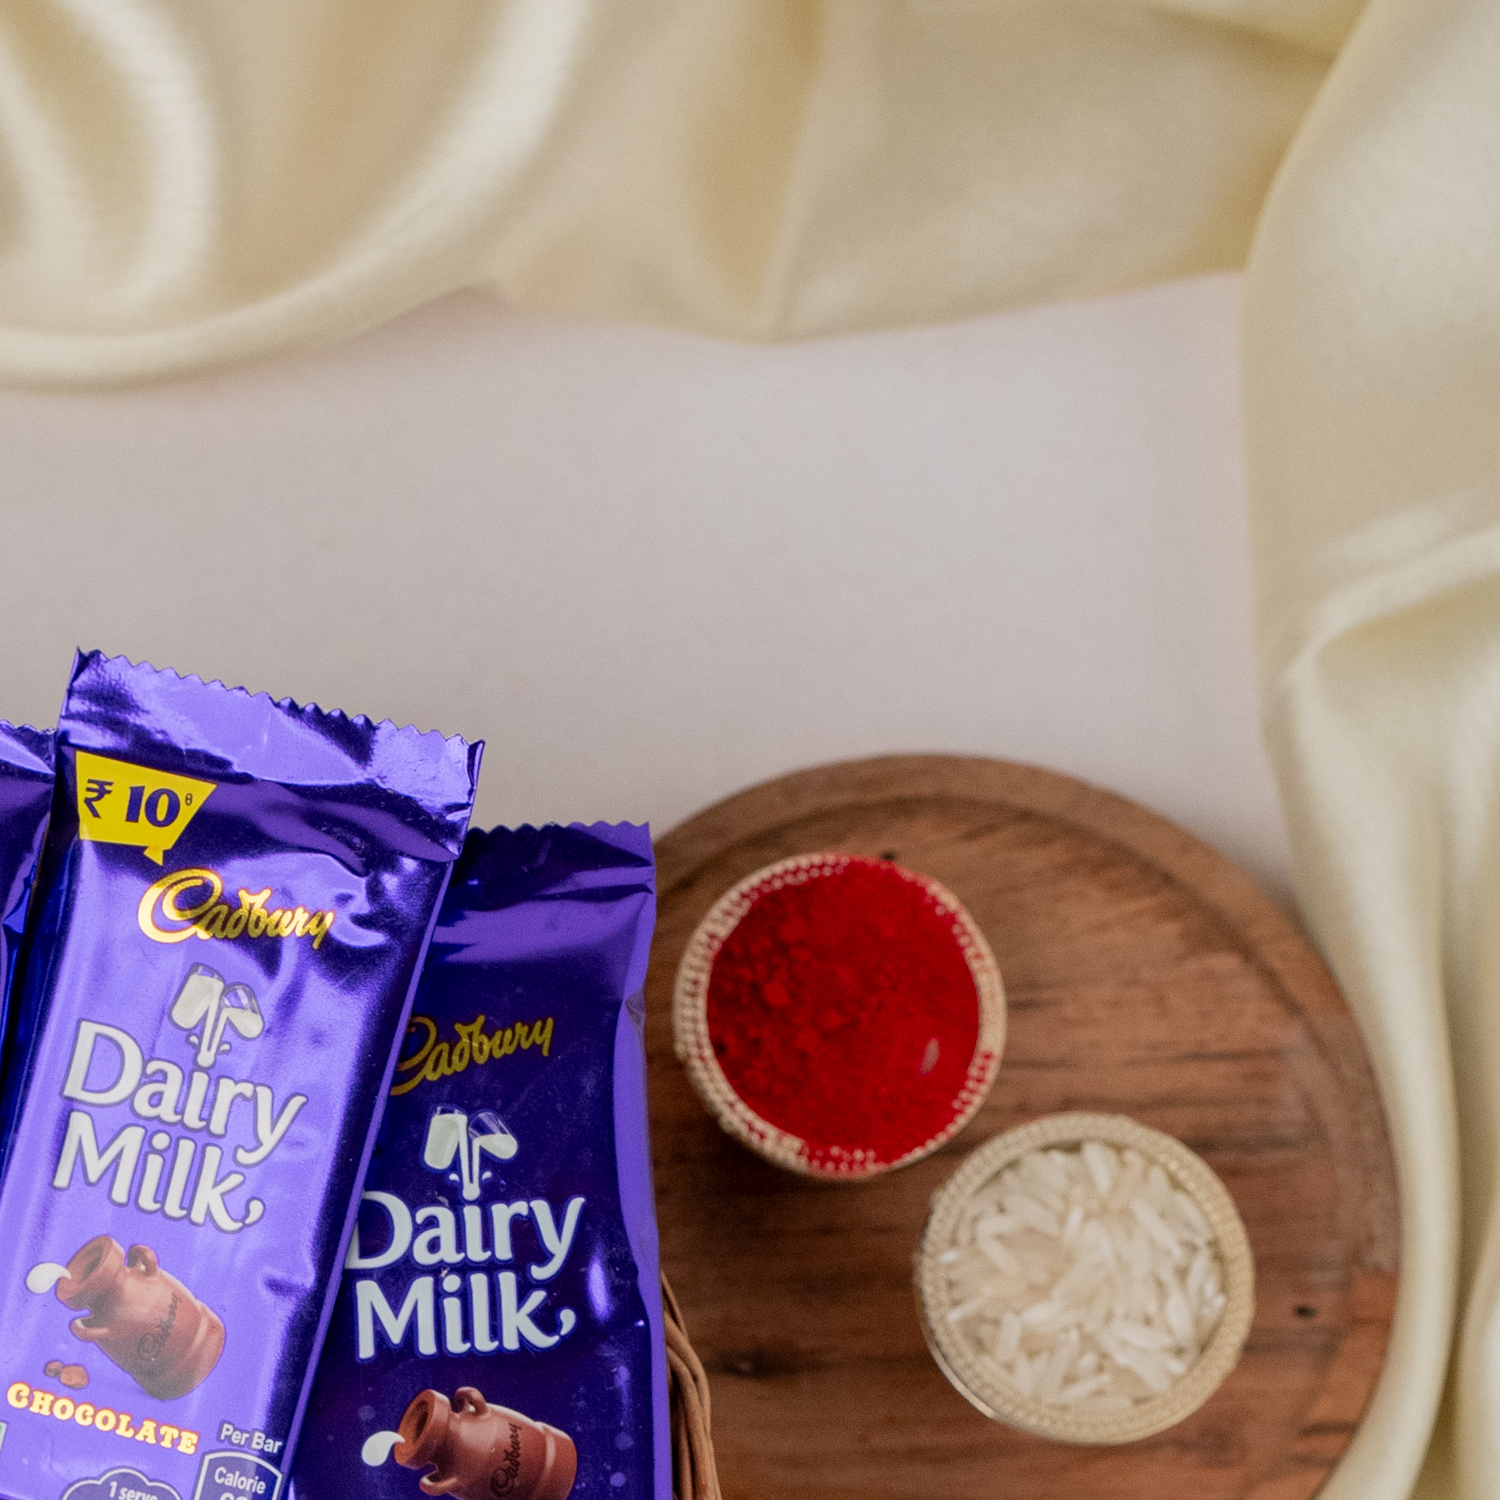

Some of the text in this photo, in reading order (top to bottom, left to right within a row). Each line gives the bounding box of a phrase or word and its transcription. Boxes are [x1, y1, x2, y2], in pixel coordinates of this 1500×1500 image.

[137, 868, 336, 949] Cadbury
[62, 1017, 308, 1167] Dairy
[393, 1014, 555, 1097] Cadbury
[52, 1111, 265, 1233] Milk
[343, 1189, 587, 1281] Dairy
[354, 1270, 577, 1360] Milk
[6, 1382, 200, 1456] CHOCOLATE
[220, 1424, 283, 1454] Per Bar
[213, 1465, 267, 1495] Calorie
